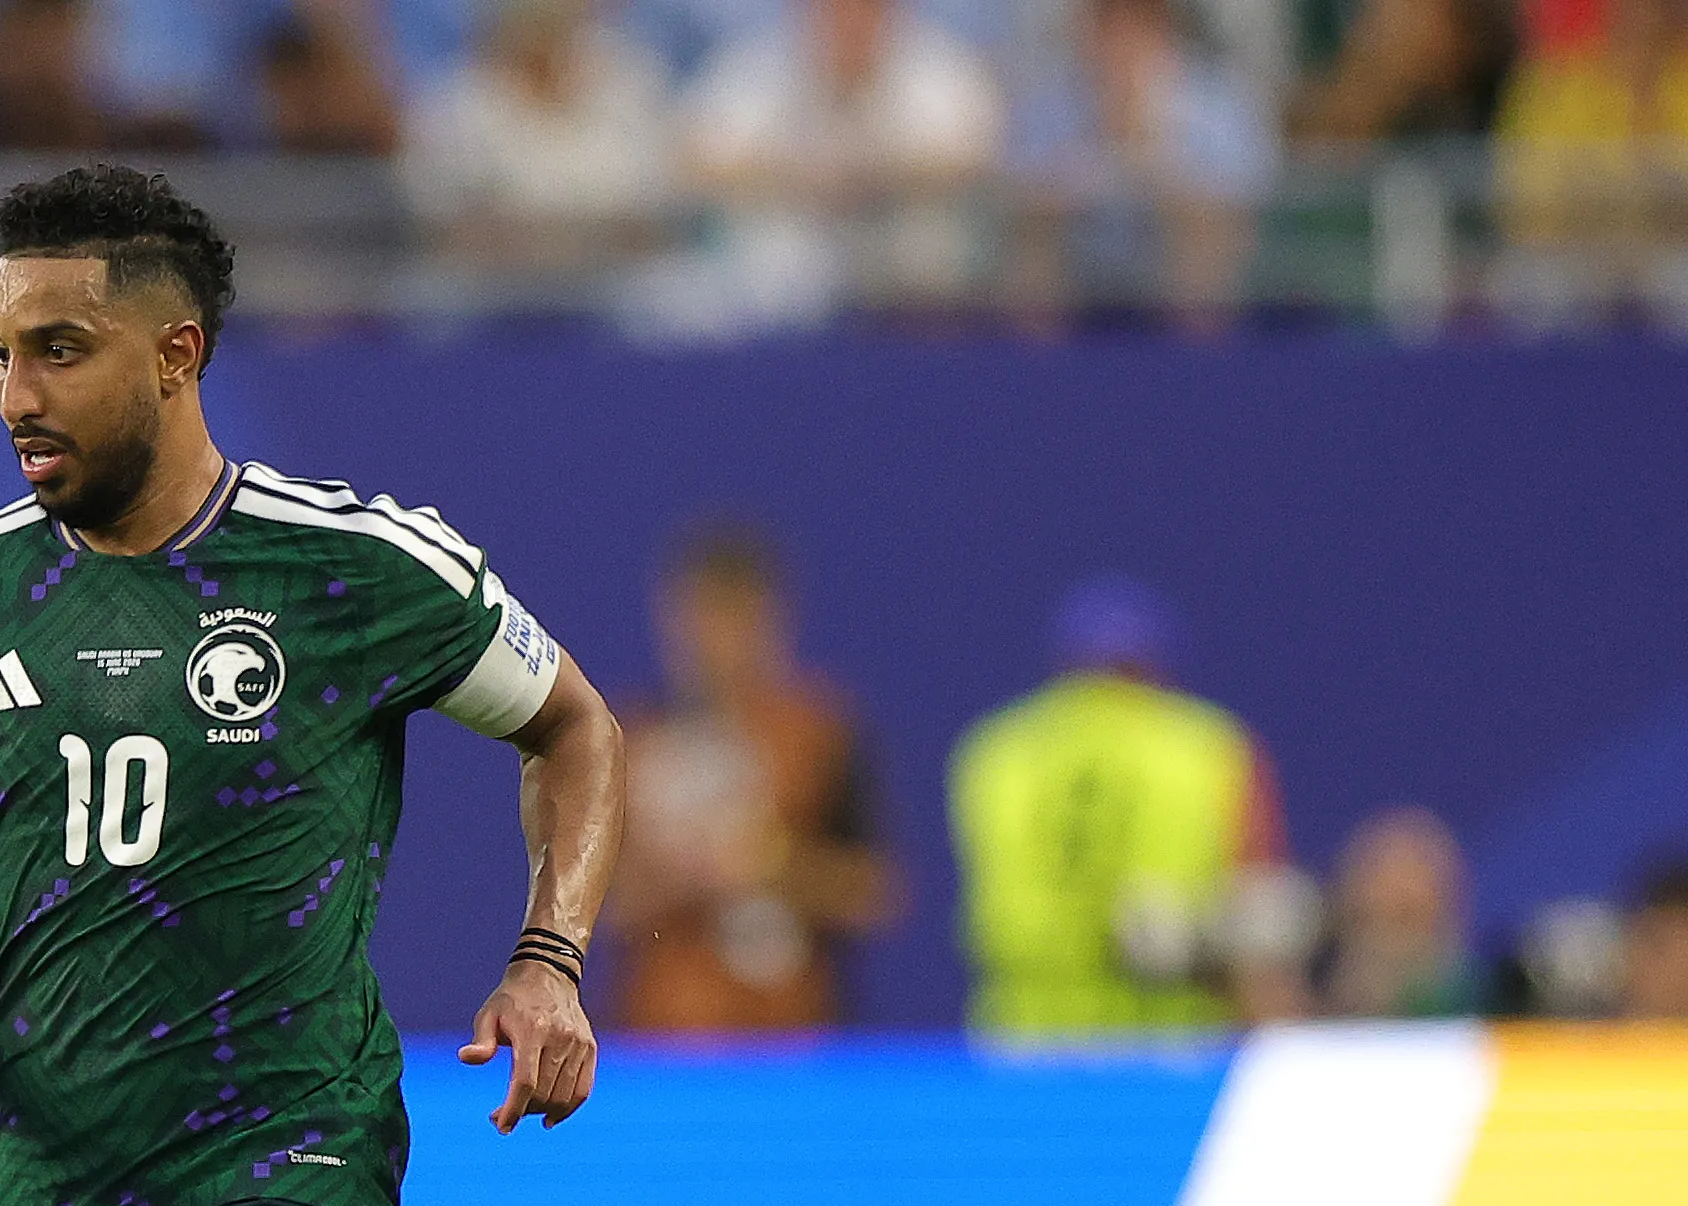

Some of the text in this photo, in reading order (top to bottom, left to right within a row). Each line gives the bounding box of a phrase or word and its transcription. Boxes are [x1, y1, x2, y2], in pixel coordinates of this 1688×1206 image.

[198, 607, 277, 629] السعودية
[237, 682, 265, 693] SAFF
[206, 728, 261, 743] SAUDI
[59, 733, 169, 866] 10
